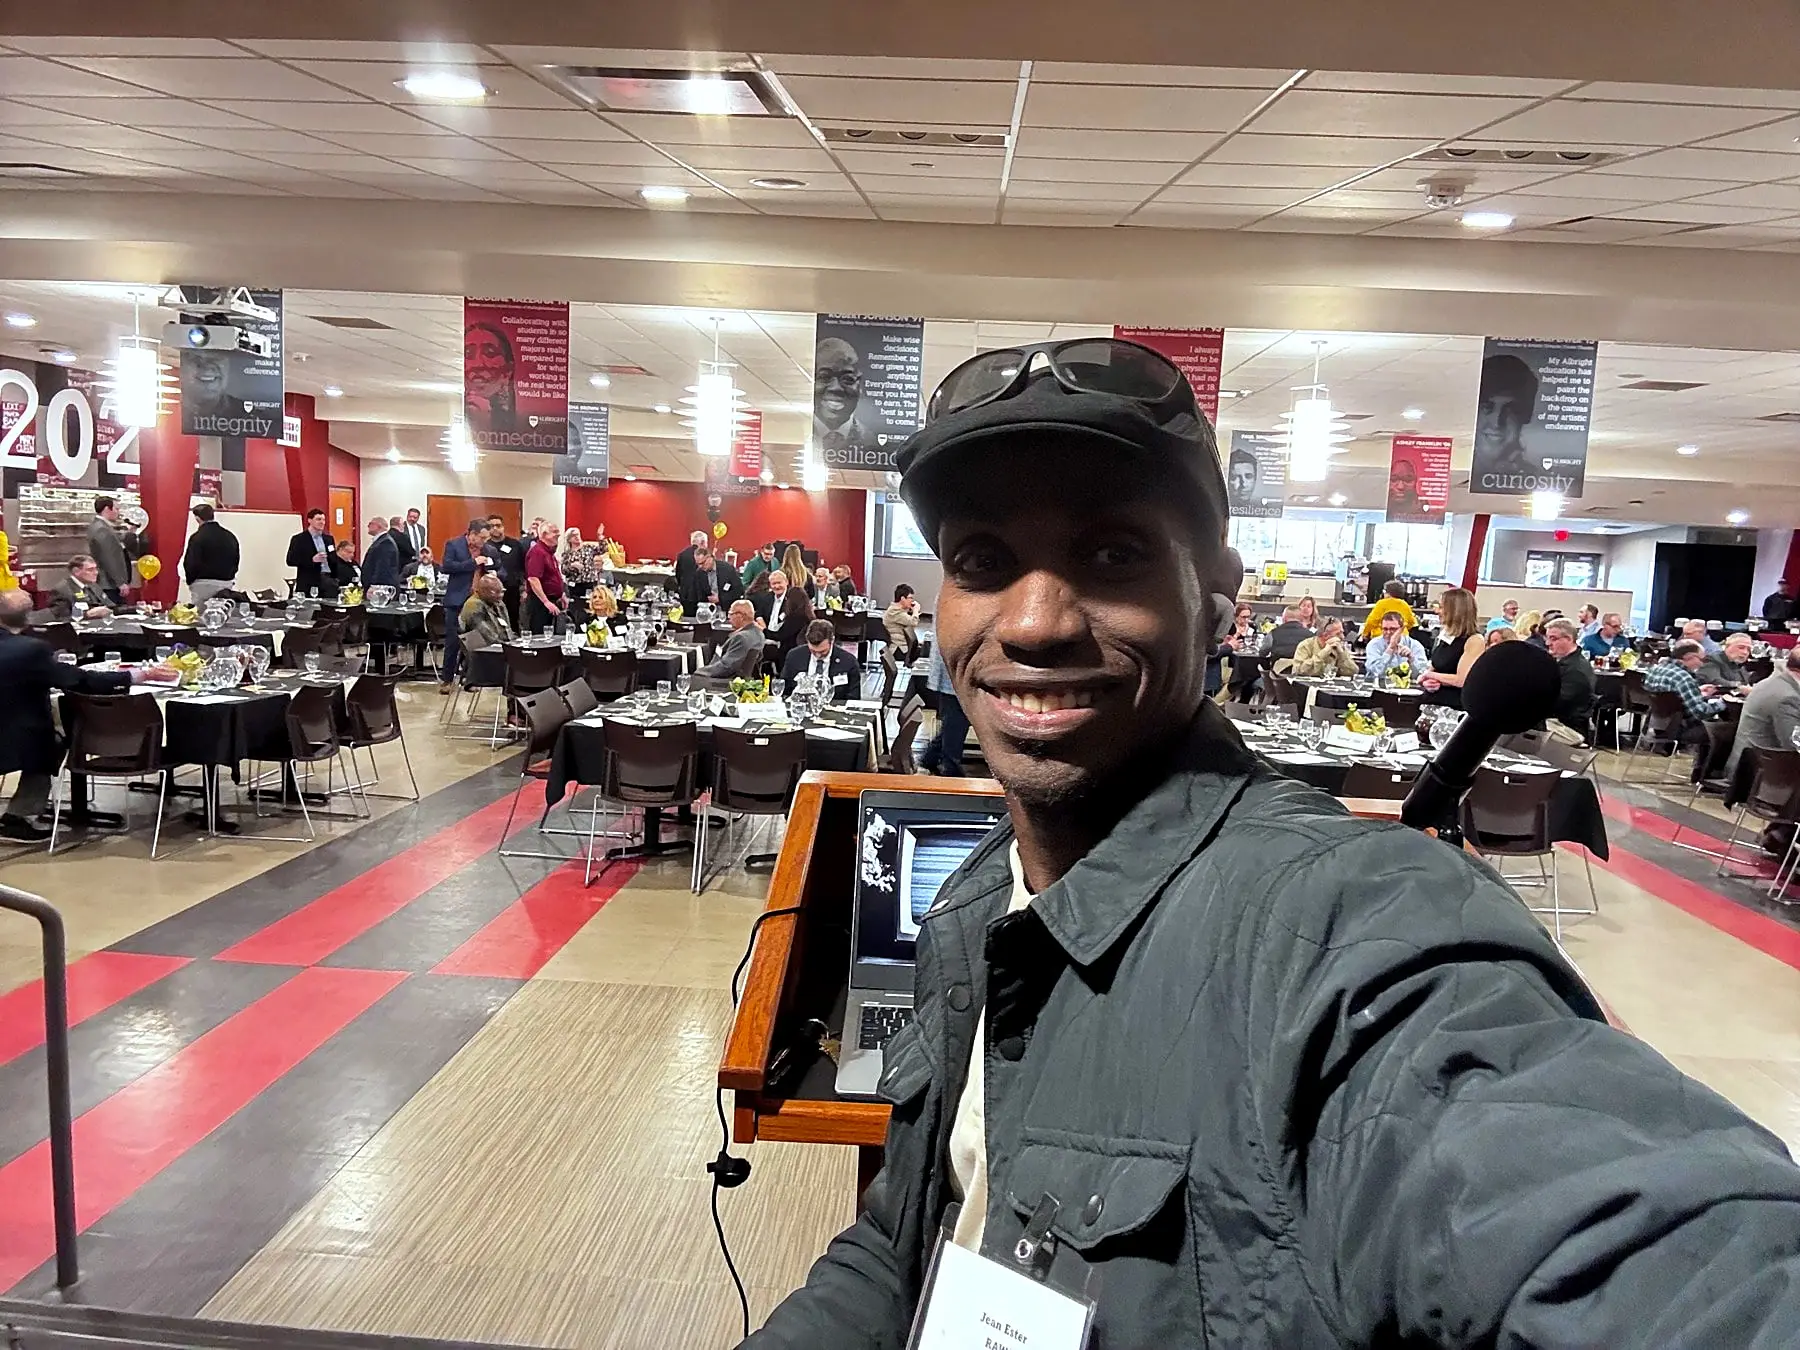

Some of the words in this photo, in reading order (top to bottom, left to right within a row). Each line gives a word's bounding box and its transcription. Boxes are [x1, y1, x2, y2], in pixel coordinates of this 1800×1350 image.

[502, 316, 550, 327] Collaborating
[552, 319, 567, 327] with
[517, 327, 548, 335] students
[516, 336, 535, 344] many
[537, 336, 567, 344] different
[882, 335, 901, 343] Make
[903, 336, 920, 344] wise
[547, 346, 566, 355] really
[1194, 346, 1220, 355] always
[522, 355, 554, 363] prepared
[1171, 355, 1199, 363] wanted
[1548, 357, 1560, 365] My
[1562, 357, 1593, 367] Albright
[549, 364, 567, 372] what
[886, 363, 904, 371] gives
[1538, 366, 1576, 374] education
[529, 372, 557, 381] working
[1542, 376, 1568, 384] helped
[546, 382, 566, 390] world
[865, 380, 903, 390] Everything
[518, 390, 540, 398] would
[1577, 386, 1590, 394] the
[900, 391, 918, 399] have
[1541, 394, 1577, 404] backdrop
[904, 400, 917, 408] The
[880, 408, 896, 416] best
[194, 413, 273, 437] integrity
[560, 473, 602, 487] integrity
[1482, 469, 1575, 494] curiosity
[980, 1312, 1002, 1331] Jean
[1004, 1323, 1028, 1344] Ester
